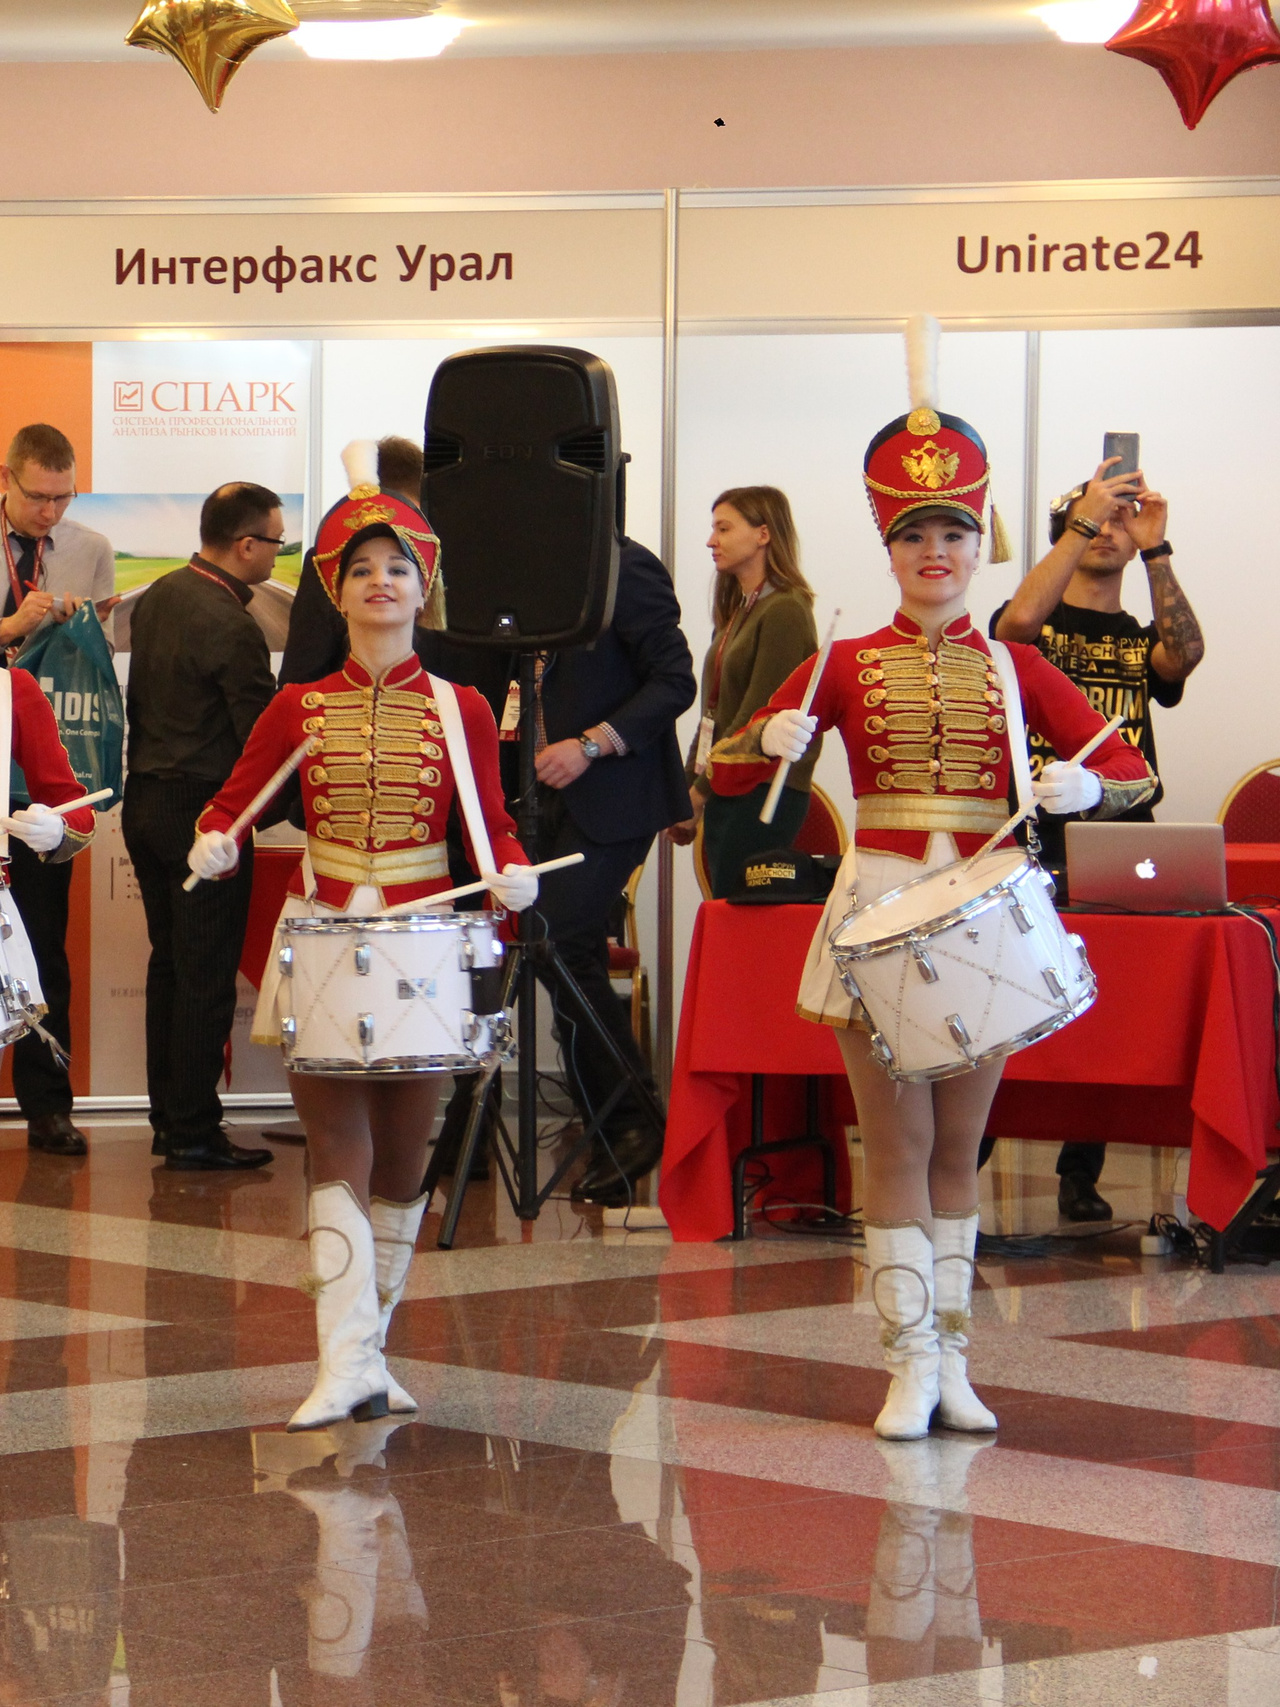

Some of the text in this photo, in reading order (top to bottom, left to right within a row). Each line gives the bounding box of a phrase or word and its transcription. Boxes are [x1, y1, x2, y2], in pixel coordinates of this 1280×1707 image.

[957, 231, 1203, 274] Unirate24
[115, 244, 513, 293] Интерфакс Урал
[151, 381, 296, 412] СПАРК
[113, 416, 297, 426] СИСТЕМА ПРОФЕССИОНАЛЬНОГО
[113, 426, 297, 437] АНАЛИЗА РЫНКОВ И КОМПАНИЙ
[1102, 634, 1150, 648] ФРУМ
[1086, 686, 1144, 720] RUM
